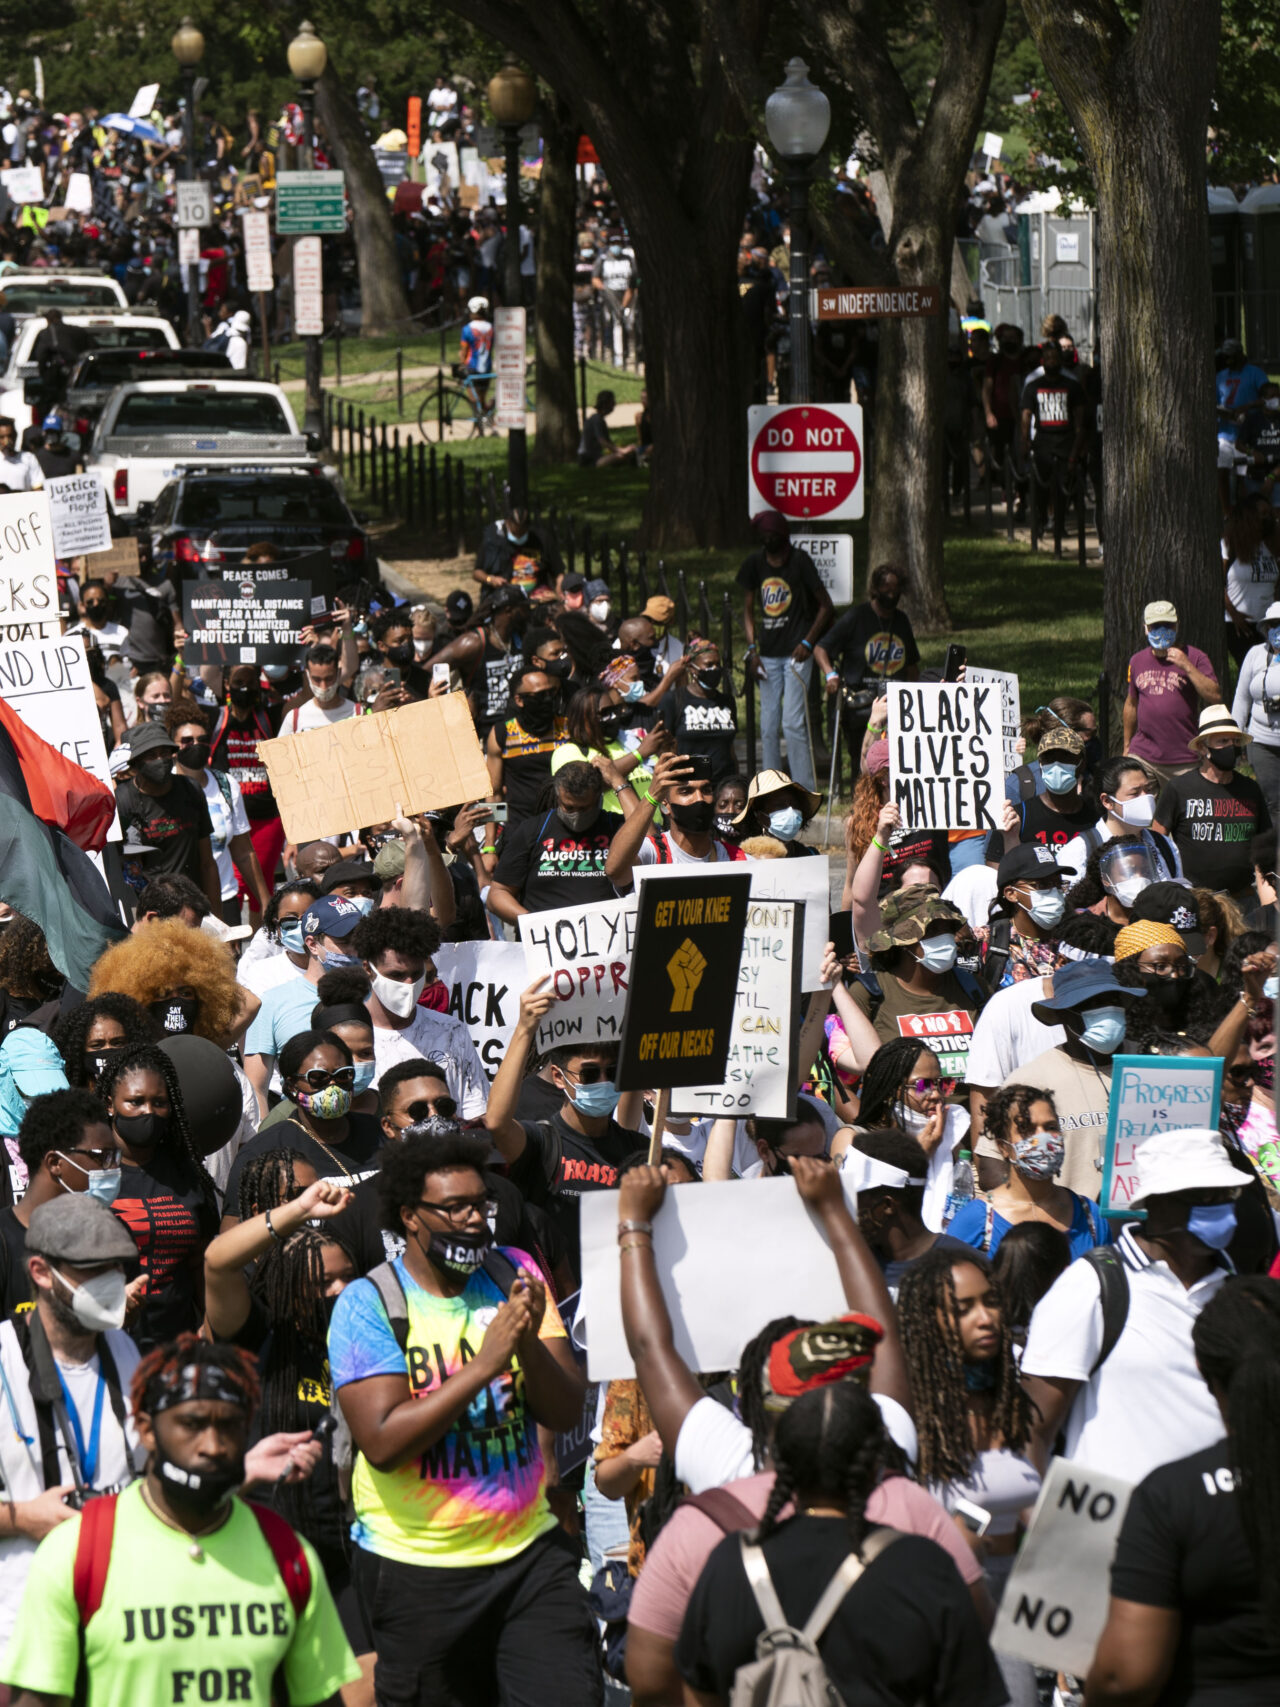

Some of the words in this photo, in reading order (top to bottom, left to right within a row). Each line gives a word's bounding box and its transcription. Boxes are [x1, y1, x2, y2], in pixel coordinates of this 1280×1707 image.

[183, 204, 205, 221] 10
[822, 299, 836, 311] SW
[838, 292, 919, 314] INDEPENDENCE
[921, 297, 933, 308] AV
[768, 428, 794, 446] DO
[806, 428, 845, 446] NOT
[50, 479, 97, 499] Justice
[61, 490, 99, 503] George
[774, 478, 837, 497] ENTER
[68, 501, 97, 513] Floyd
[791, 540, 839, 556] CEPT
[222, 570, 253, 582] PEACE
[255, 568, 288, 582] COMES
[190, 599, 231, 610] MAINTAIN
[232, 599, 263, 610] SOCIAL
[263, 599, 304, 610] DISTANCE
[762, 583, 790, 607] Vote
[218, 609, 243, 619] WEAR
[244, 609, 251, 619] A
[252, 609, 277, 619] MASK
[205, 619, 222, 630] USE
[223, 619, 246, 630] HAND
[247, 619, 290, 630] SANITIZER
[192, 630, 244, 644] PROTECT
[247, 630, 270, 644] THE
[272, 630, 303, 645] VOTE
[867, 641, 904, 665] Vote
[41, 646, 81, 689] UP
[898, 686, 992, 735] BLACK
[898, 735, 990, 778] LIVES
[895, 777, 997, 829] MATTER
[1191, 822, 1213, 842] NOT
[1215, 822, 1223, 842] A
[540, 850, 591, 861] AUGUST
[655, 901, 676, 928] GET
[676, 898, 704, 926] YOUR
[704, 896, 732, 923] KNEE
[530, 914, 600, 968] 401
[738, 966, 761, 984] SY
[169, 1006, 182, 1015] SAY
[448, 980, 509, 1028] ACK
[735, 991, 770, 1010] TIL
[164, 1020, 188, 1030] NAMES
[166, 1013, 185, 1022] THEIR
[740, 1015, 782, 1036] CAN
[924, 1016, 948, 1033] NO
[539, 1015, 583, 1047] HOW
[639, 1033, 658, 1061] OFF
[658, 1031, 679, 1060] OUR
[679, 1028, 715, 1058] NECKS
[694, 1091, 752, 1108] TOO
[1120, 1072, 1213, 1107] PROGRESS
[1058, 1111, 1109, 1132] PACIF
[1152, 1109, 1168, 1119] IS
[146, 1196, 174, 1204] WORTHY
[408, 1337, 478, 1391] BLA
[1057, 1478, 1116, 1522] NO
[122, 1602, 289, 1643] JUSTICE
[1013, 1593, 1074, 1639] NO
[171, 1668, 254, 1702] FOR
